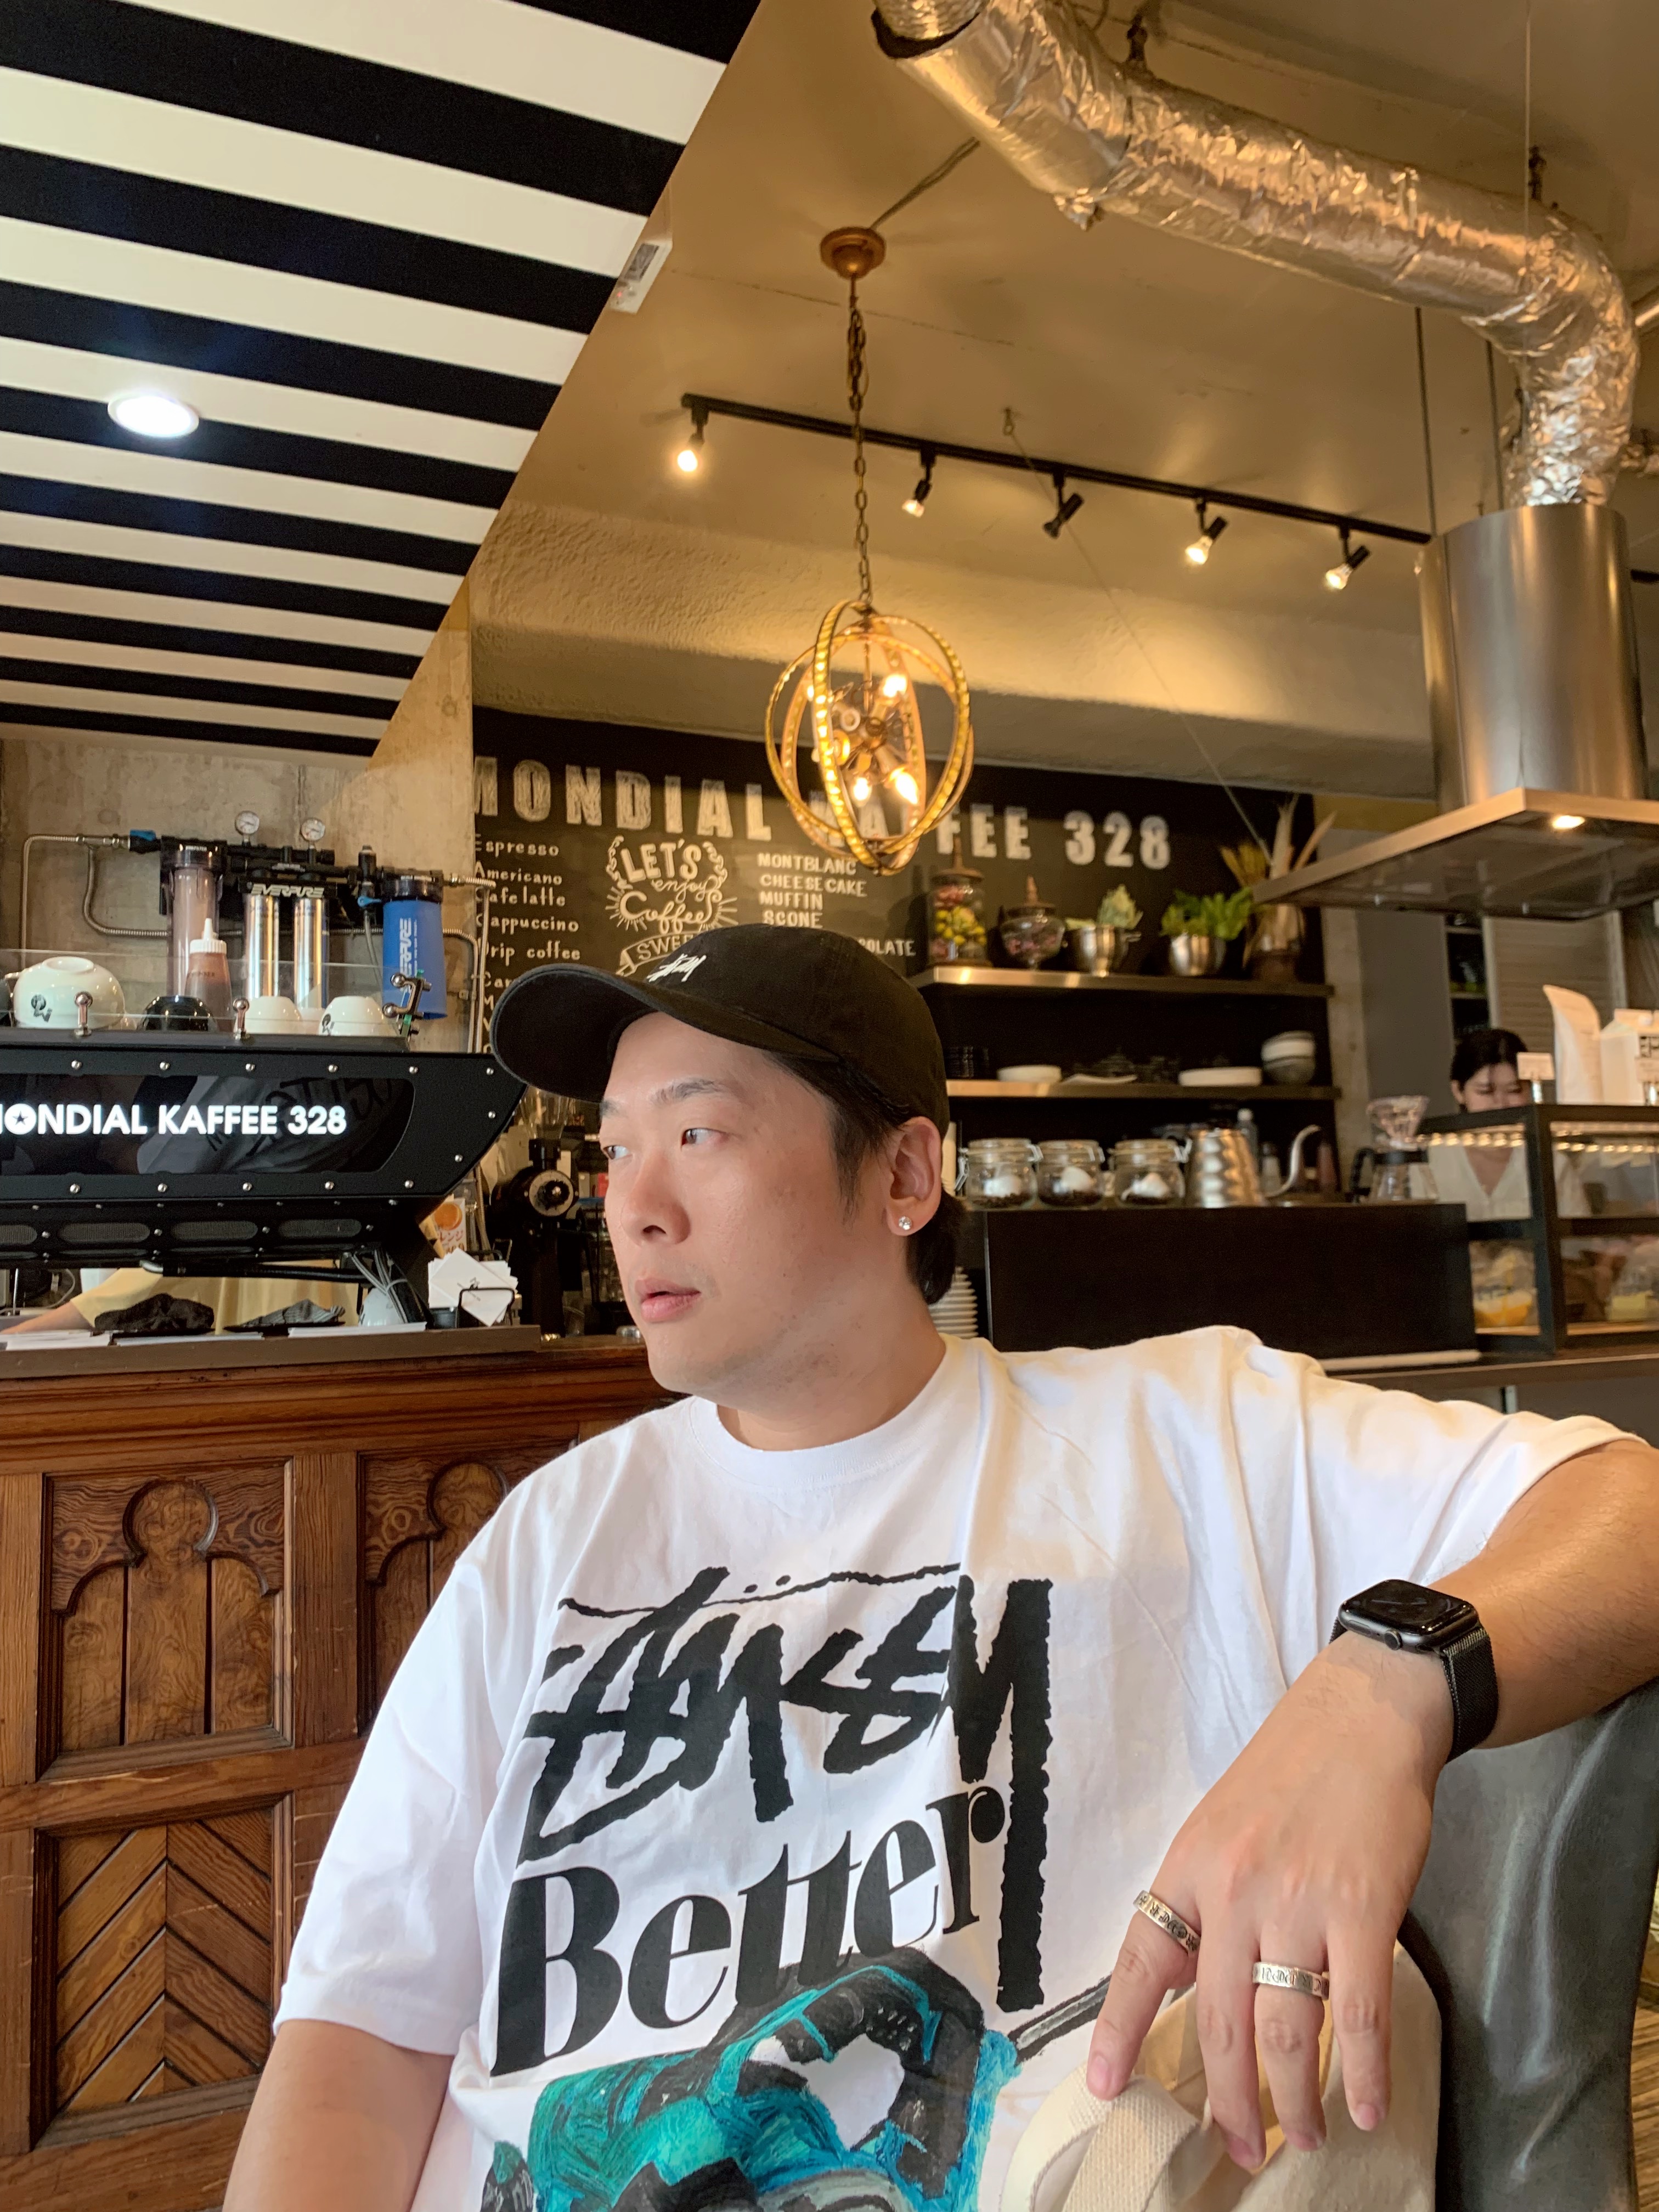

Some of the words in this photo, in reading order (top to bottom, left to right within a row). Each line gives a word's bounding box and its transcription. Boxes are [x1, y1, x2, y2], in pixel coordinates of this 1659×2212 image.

[1063, 809, 1171, 870] 328
[620, 838, 702, 883] LET'S
[757, 853, 856, 876] MONTBLANC
[475, 860, 563, 886] Americano
[523, 885, 566, 907] latte
[758, 890, 823, 911] MUFFIN
[761, 910, 823, 929] SCONE
[527, 940, 581, 961] coffee
[158, 1105, 278, 1135] KAFFEE
[287, 1105, 347, 1135] 328
[489, 1785, 1006, 2078] Better
